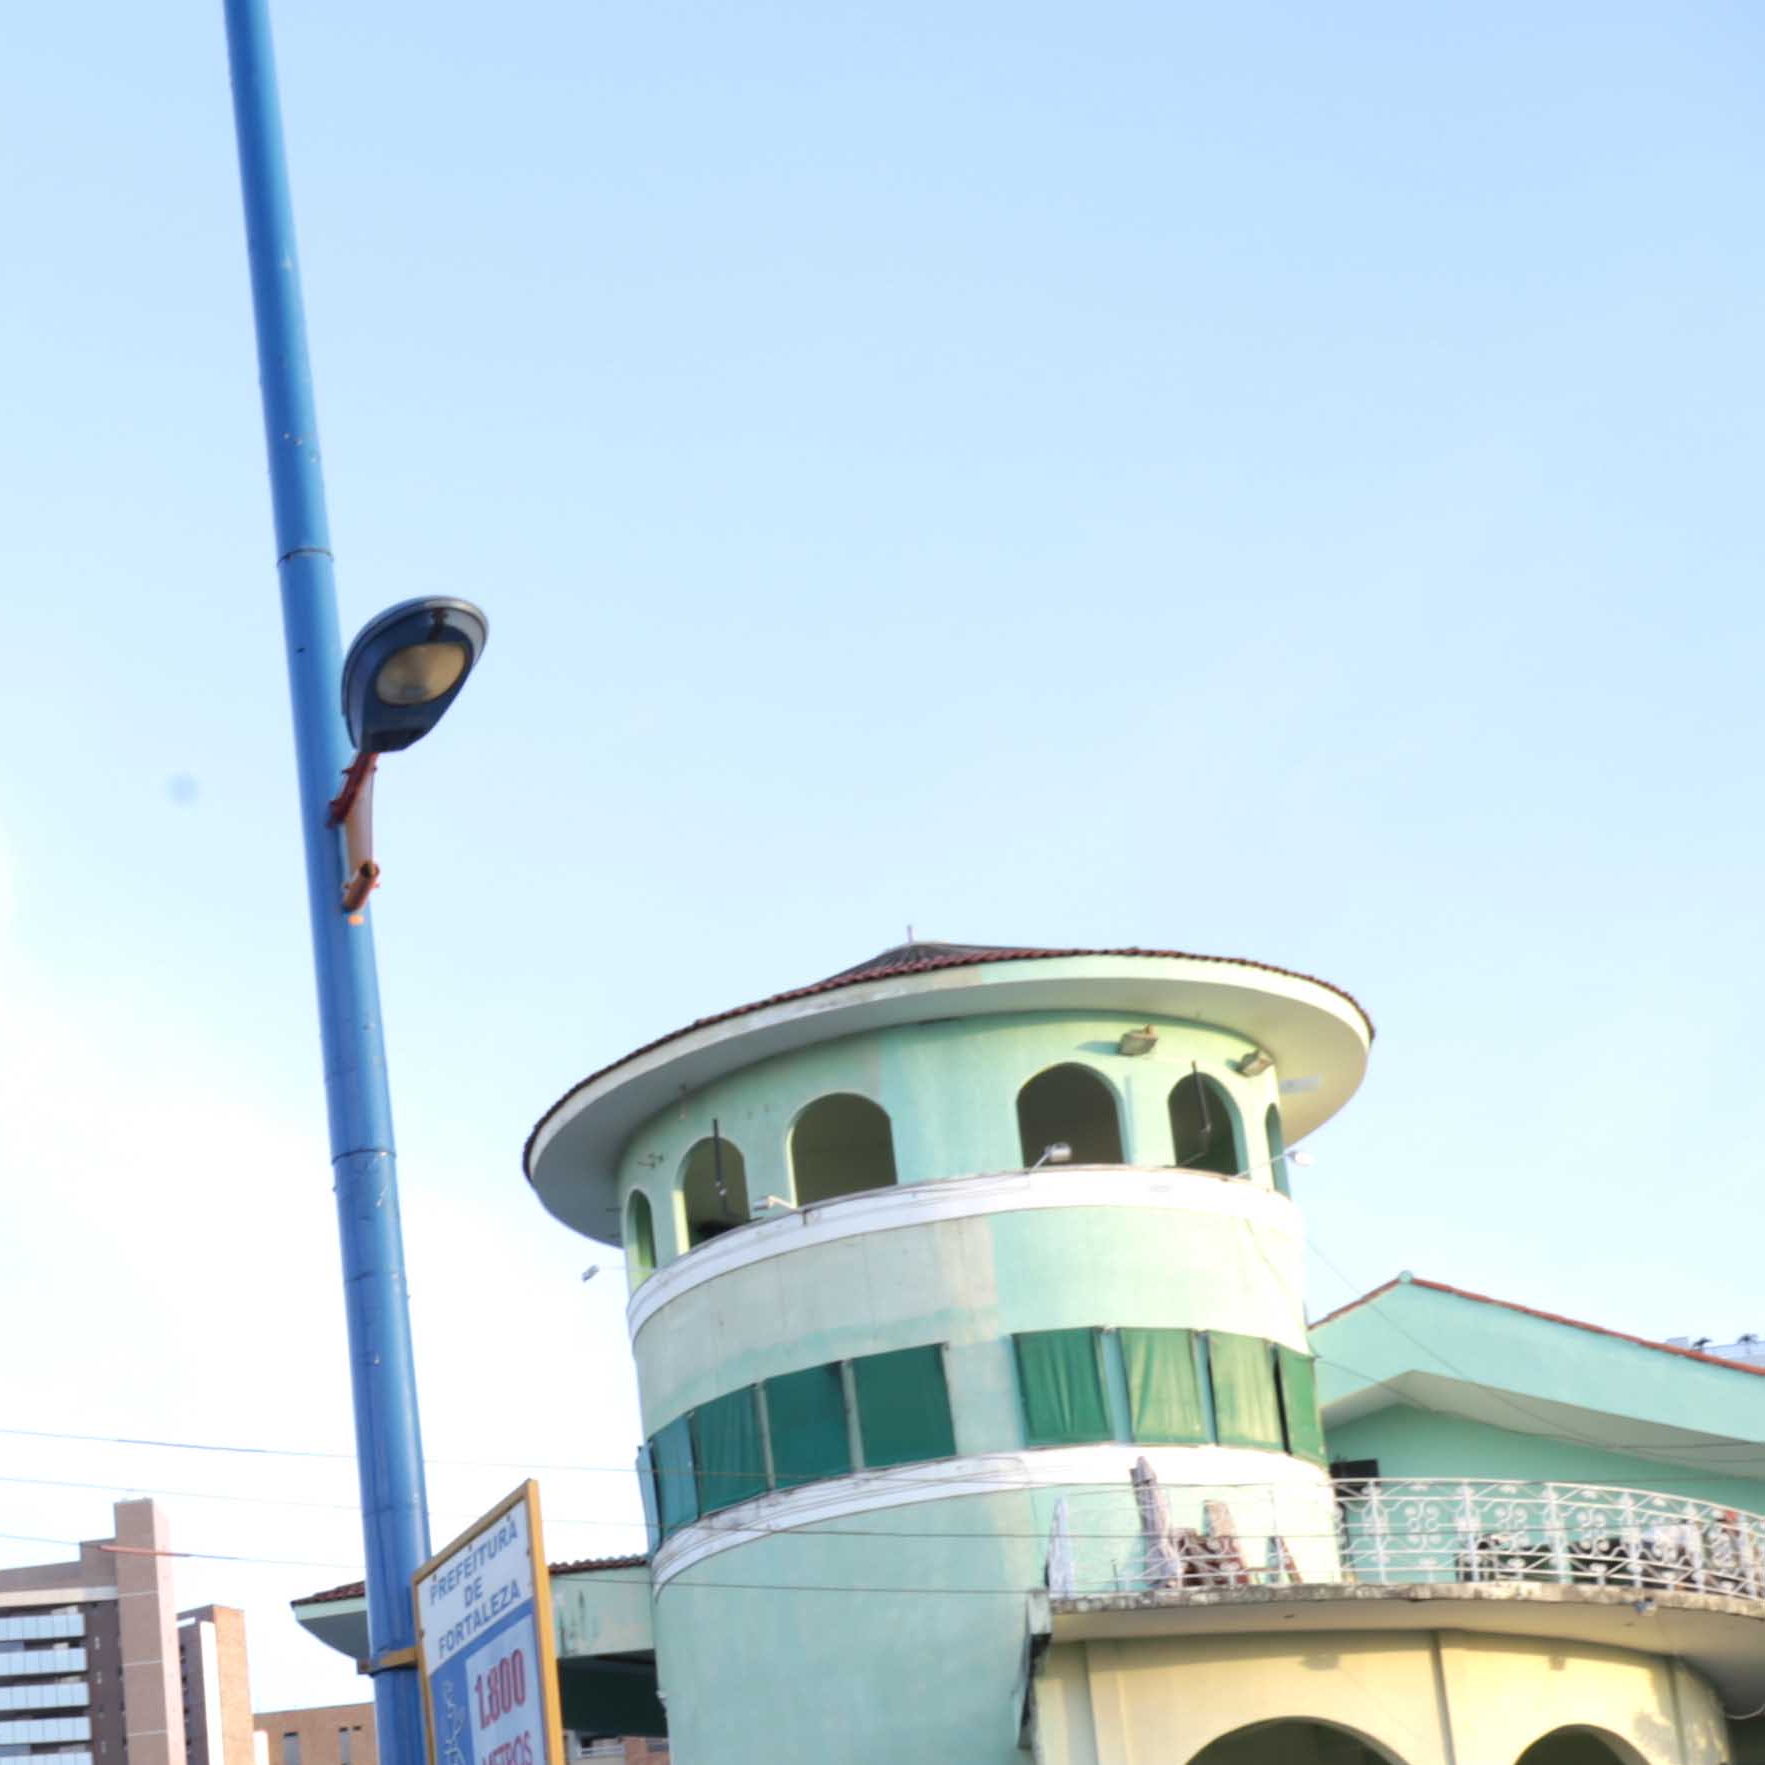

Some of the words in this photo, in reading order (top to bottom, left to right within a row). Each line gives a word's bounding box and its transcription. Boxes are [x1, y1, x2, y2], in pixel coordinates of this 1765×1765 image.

[429, 1519, 519, 1606] PREFEITURA
[464, 1576, 484, 1608] DE
[438, 1579, 521, 1659] FORTALEZA
[474, 1648, 526, 1730] 1.800
